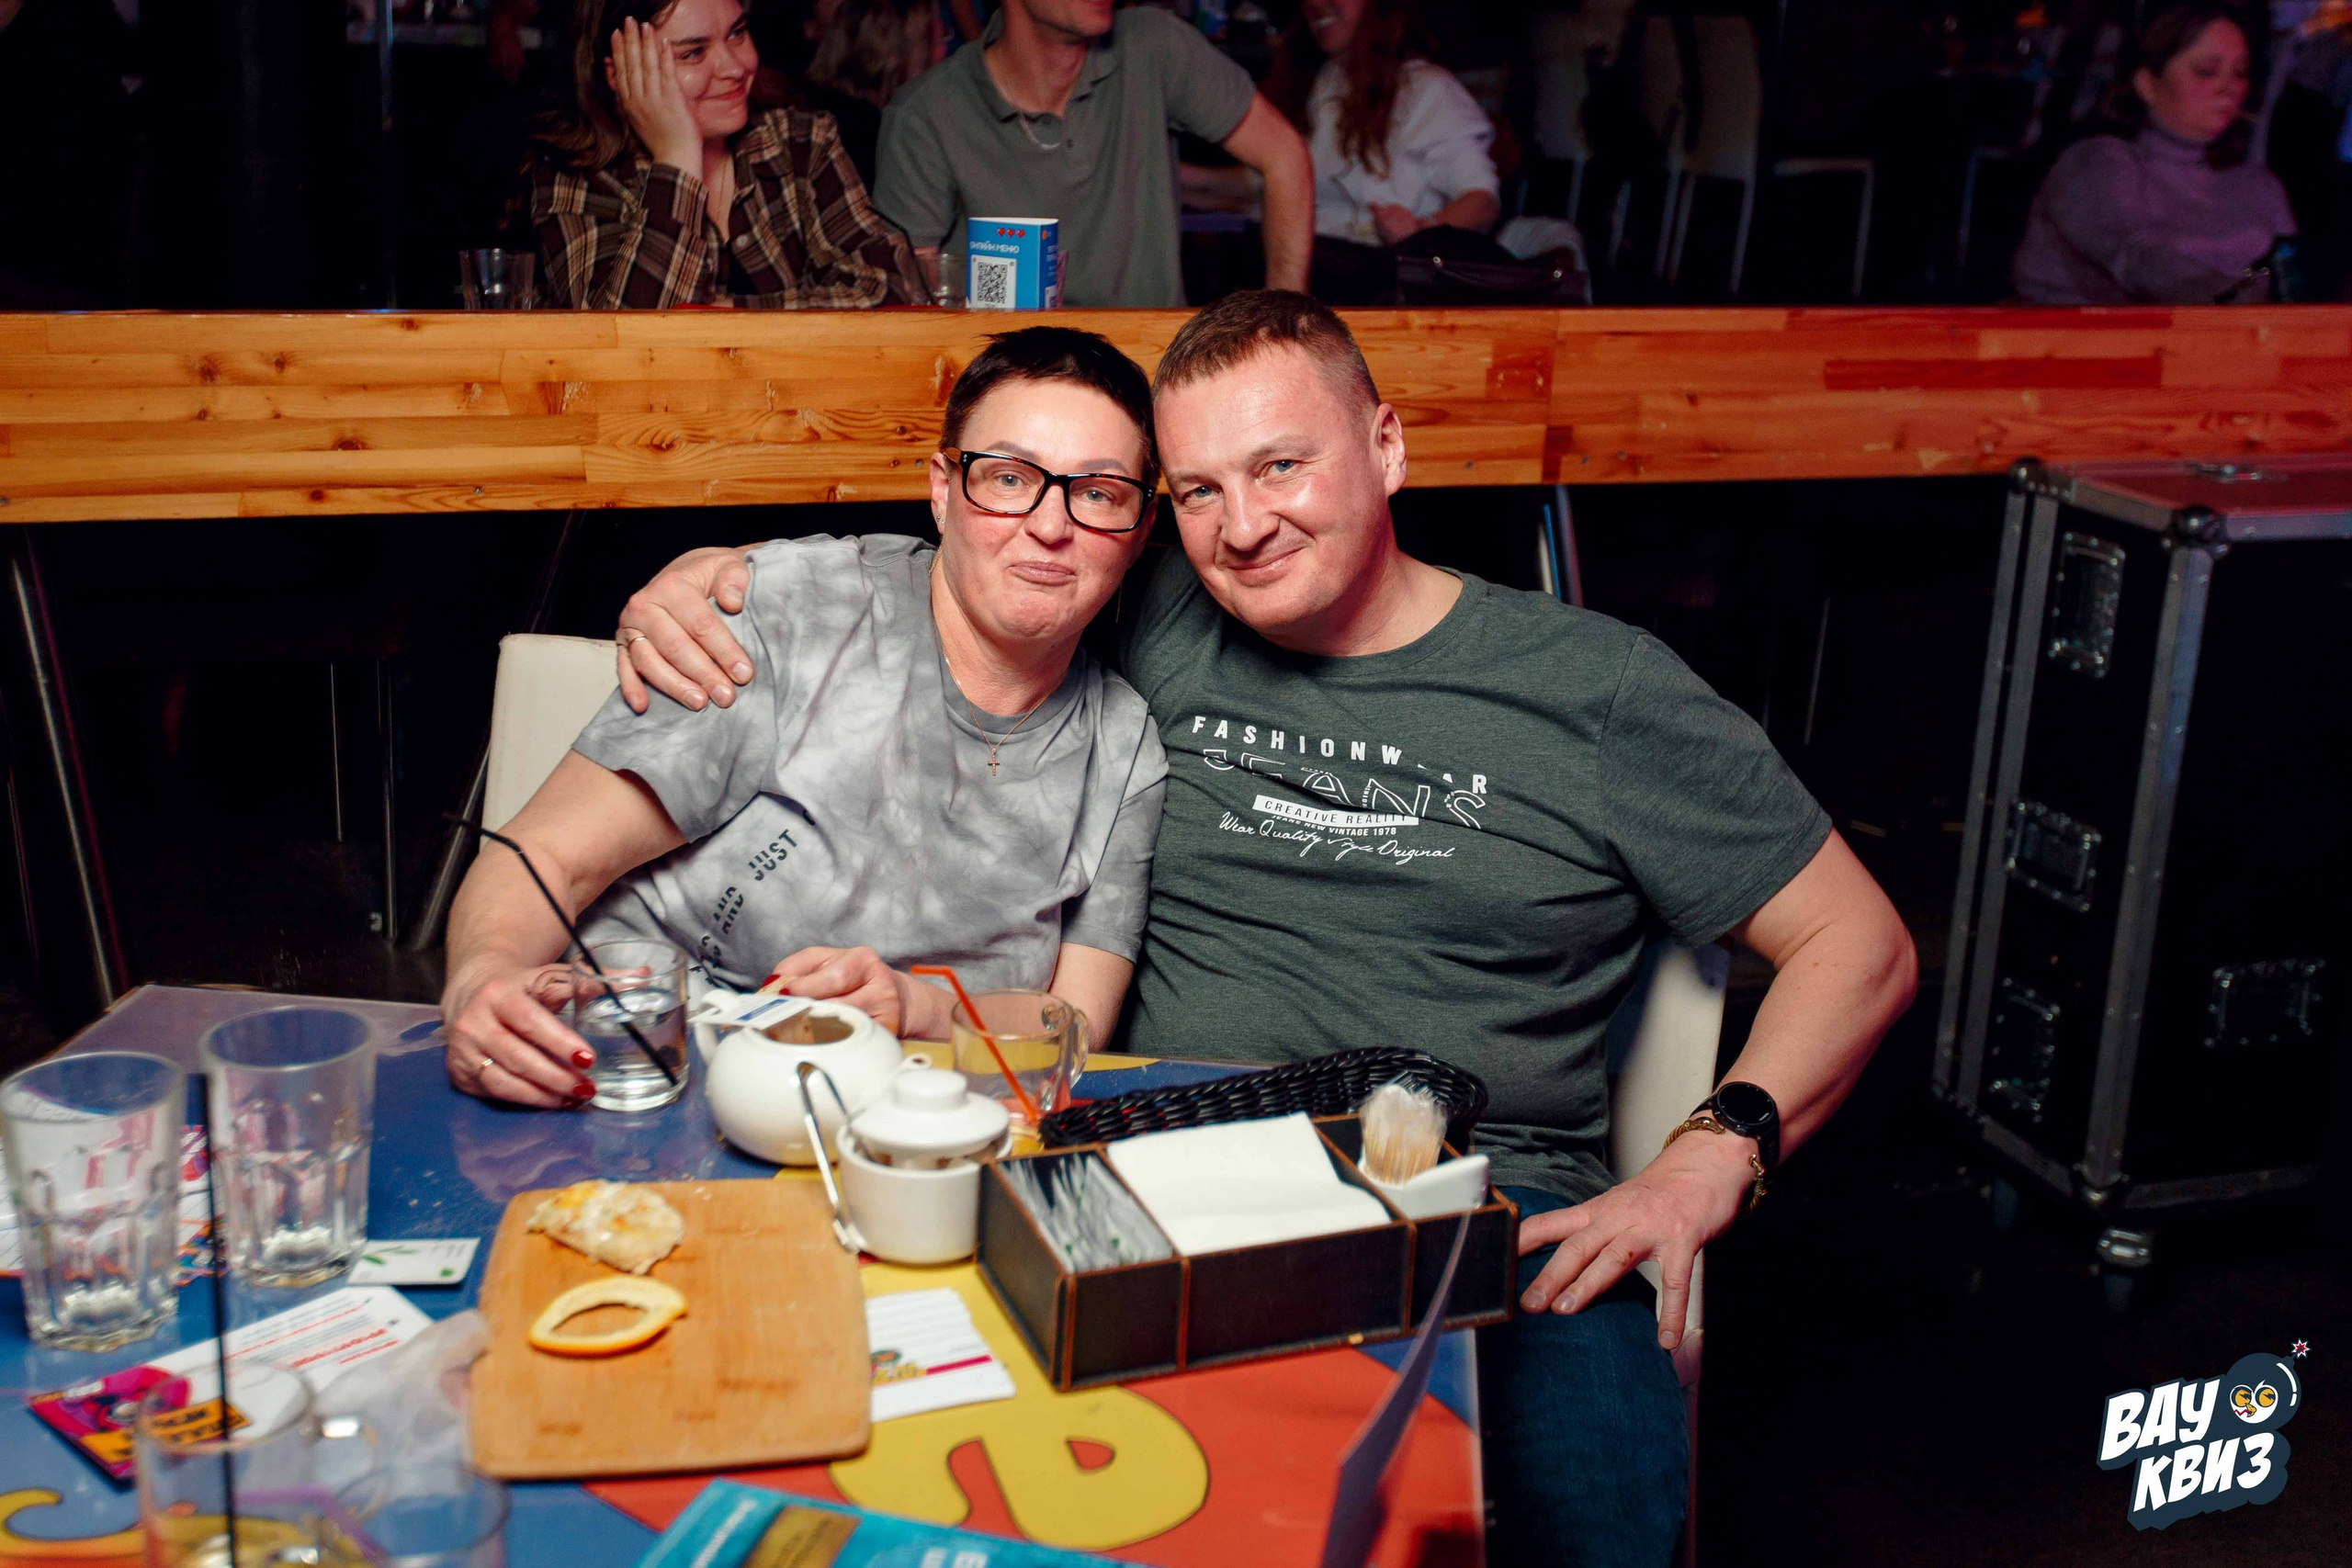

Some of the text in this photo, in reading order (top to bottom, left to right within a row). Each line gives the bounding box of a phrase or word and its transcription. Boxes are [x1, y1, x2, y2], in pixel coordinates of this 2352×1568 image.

[1192, 716, 1487, 794] FASHIONWR
[1218, 811, 1256, 835] Wear
[1259, 819, 1323, 858] Quality
[1376, 840, 1456, 865] Original
[1264, 800, 1338, 823] CREATIVE
[1304, 822, 1326, 831] NEW
[1329, 826, 1369, 836] VINTAGE
[1373, 827, 1397, 836] 1978
[747, 828, 798, 882] JUST
